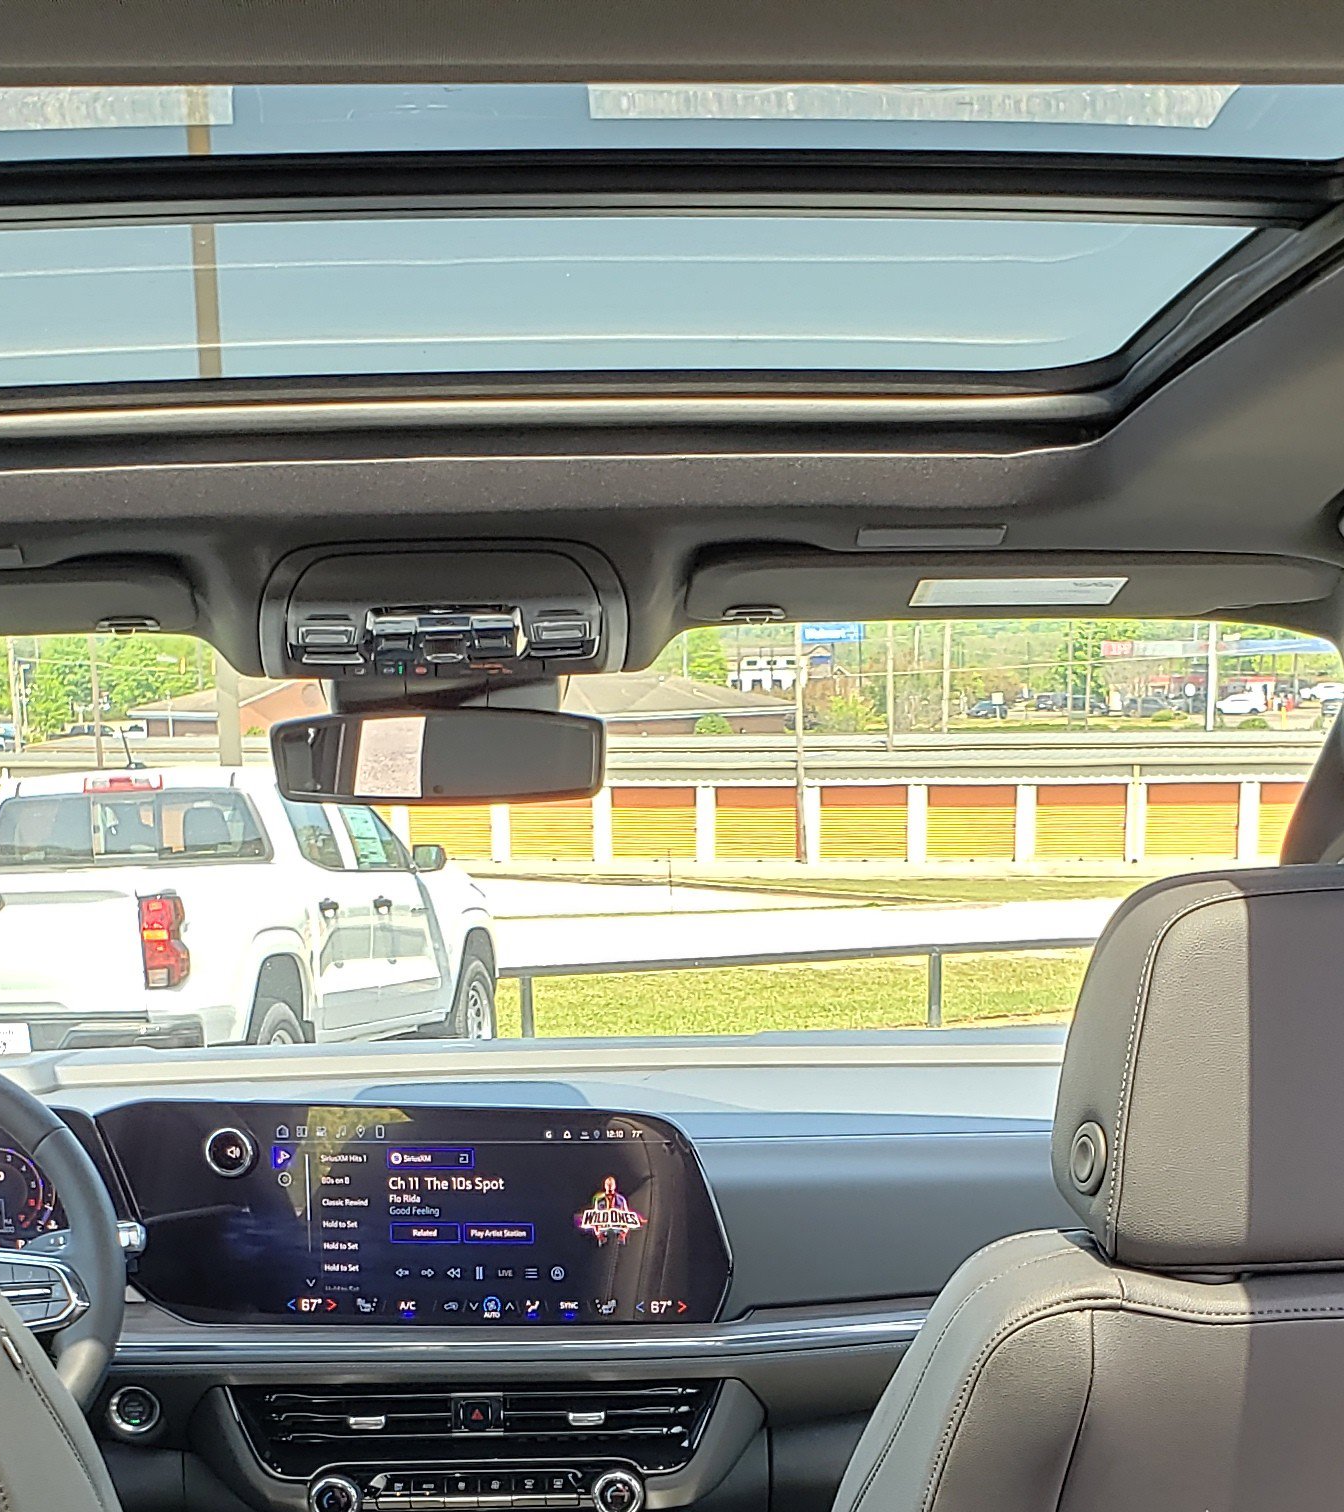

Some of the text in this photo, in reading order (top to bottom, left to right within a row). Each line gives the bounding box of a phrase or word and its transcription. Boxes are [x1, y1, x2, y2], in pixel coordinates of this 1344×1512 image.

[403, 1154, 431, 1163] SiriusXM
[388, 1176, 505, 1194] Ch 11 The 10s Spot
[321, 1198, 369, 1206] Classic Rewind
[389, 1194, 421, 1203] Flo Rida
[389, 1206, 440, 1217] Good Feeling
[610, 1210, 638, 1225] ONES
[322, 1220, 339, 1229] Hold
[346, 1220, 358, 1229] Set
[412, 1229, 438, 1237] Related
[470, 1229, 527, 1239] Play Artist Station
[323, 1242, 340, 1251] Hold
[347, 1242, 359, 1251] Set
[324, 1264, 341, 1273] Hold
[348, 1264, 360, 1273] Set
[498, 1269, 513, 1277] LIVE
[301, 1298, 322, 1311] 67°
[399, 1301, 416, 1310] A/C
[559, 1301, 578, 1310] SYNC
[650, 1300, 673, 1314] 67°
